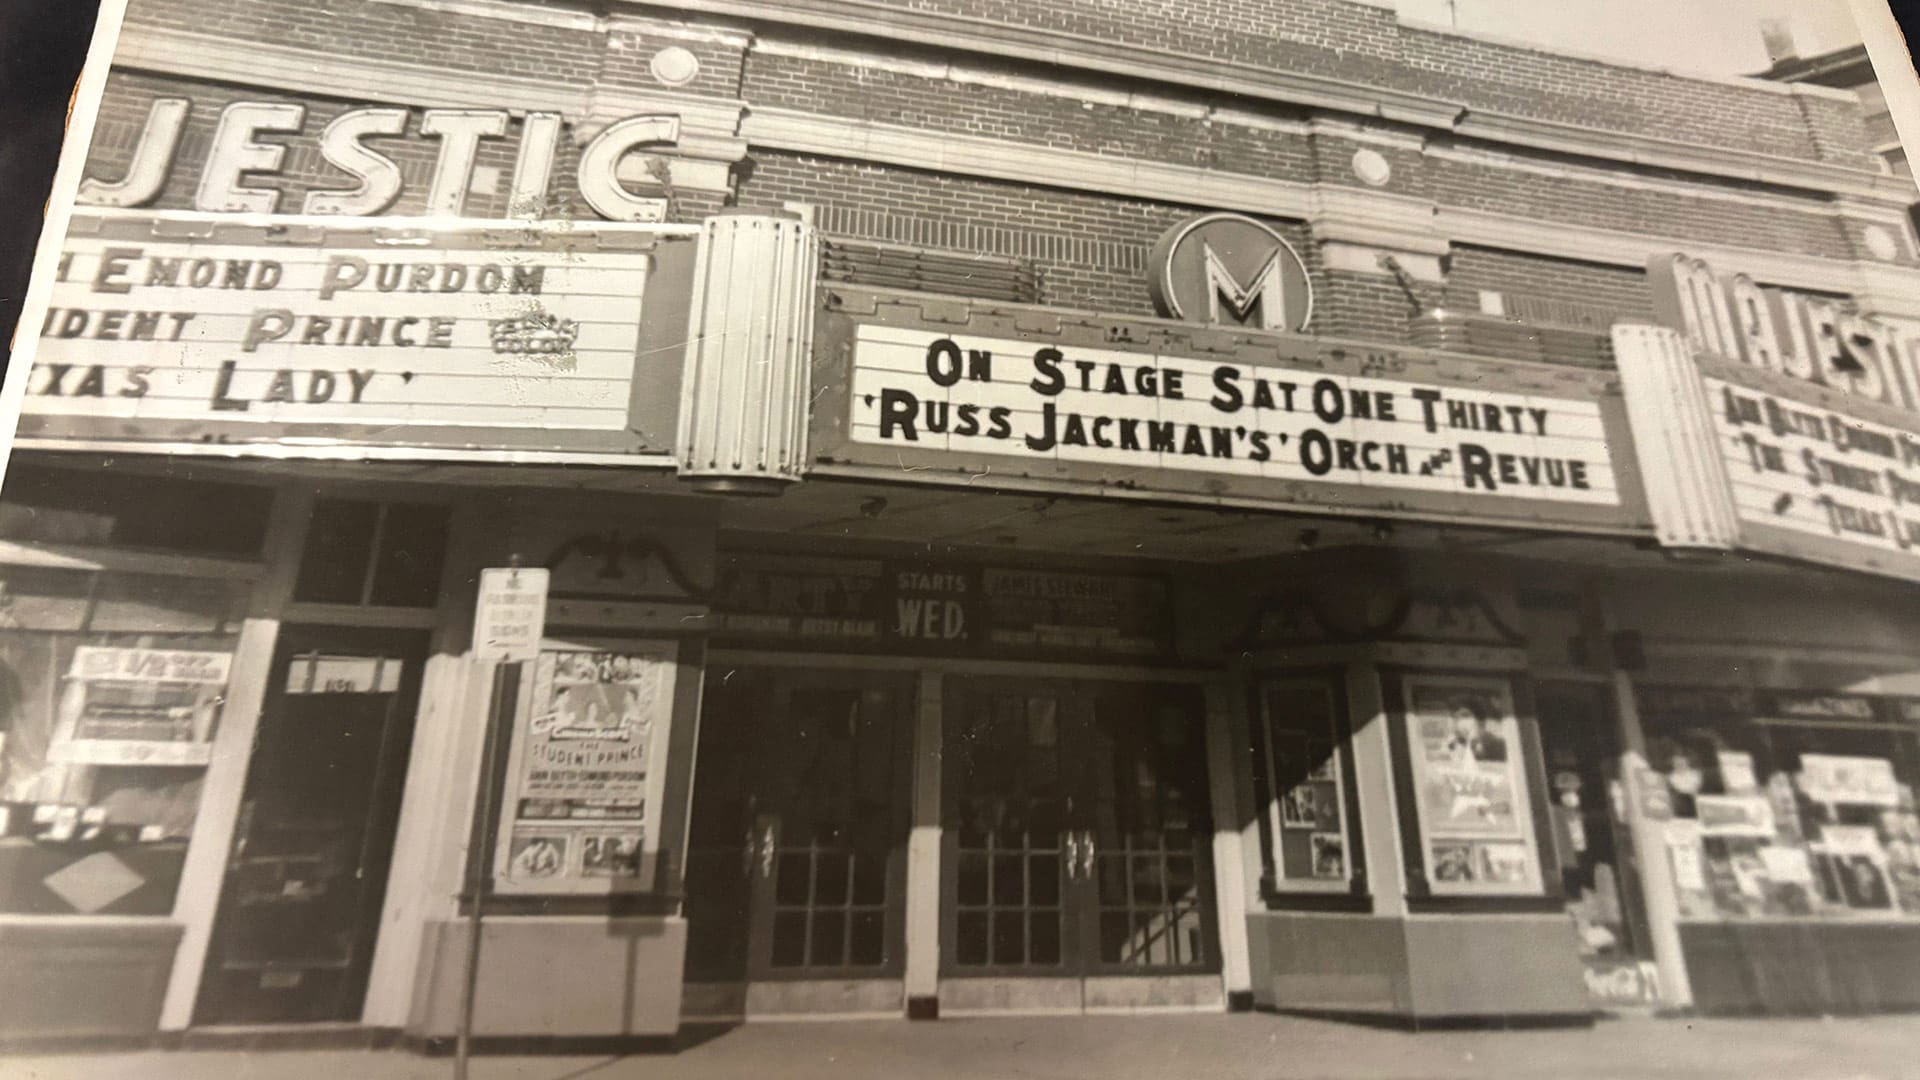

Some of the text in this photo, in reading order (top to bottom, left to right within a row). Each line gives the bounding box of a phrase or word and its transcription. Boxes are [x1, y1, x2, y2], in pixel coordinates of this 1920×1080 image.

[76, 98, 682, 223] JESTIC
[91, 247, 283, 294] EMOND
[318, 254, 546, 301] PURDOM
[1203, 242, 1287, 331] M
[242, 308, 456, 352] PRINCE
[27, 363, 154, 398] XAS
[925, 338, 1548, 436] ON STAGE SAT ONE THIRTY
[1300, 428, 1410, 476] ORCH
[1458, 442, 1591, 491] REVUE
[898, 572, 967, 593] STARTS
[897, 599, 969, 639] WED.
[597, 743, 644, 765] PRINCE
